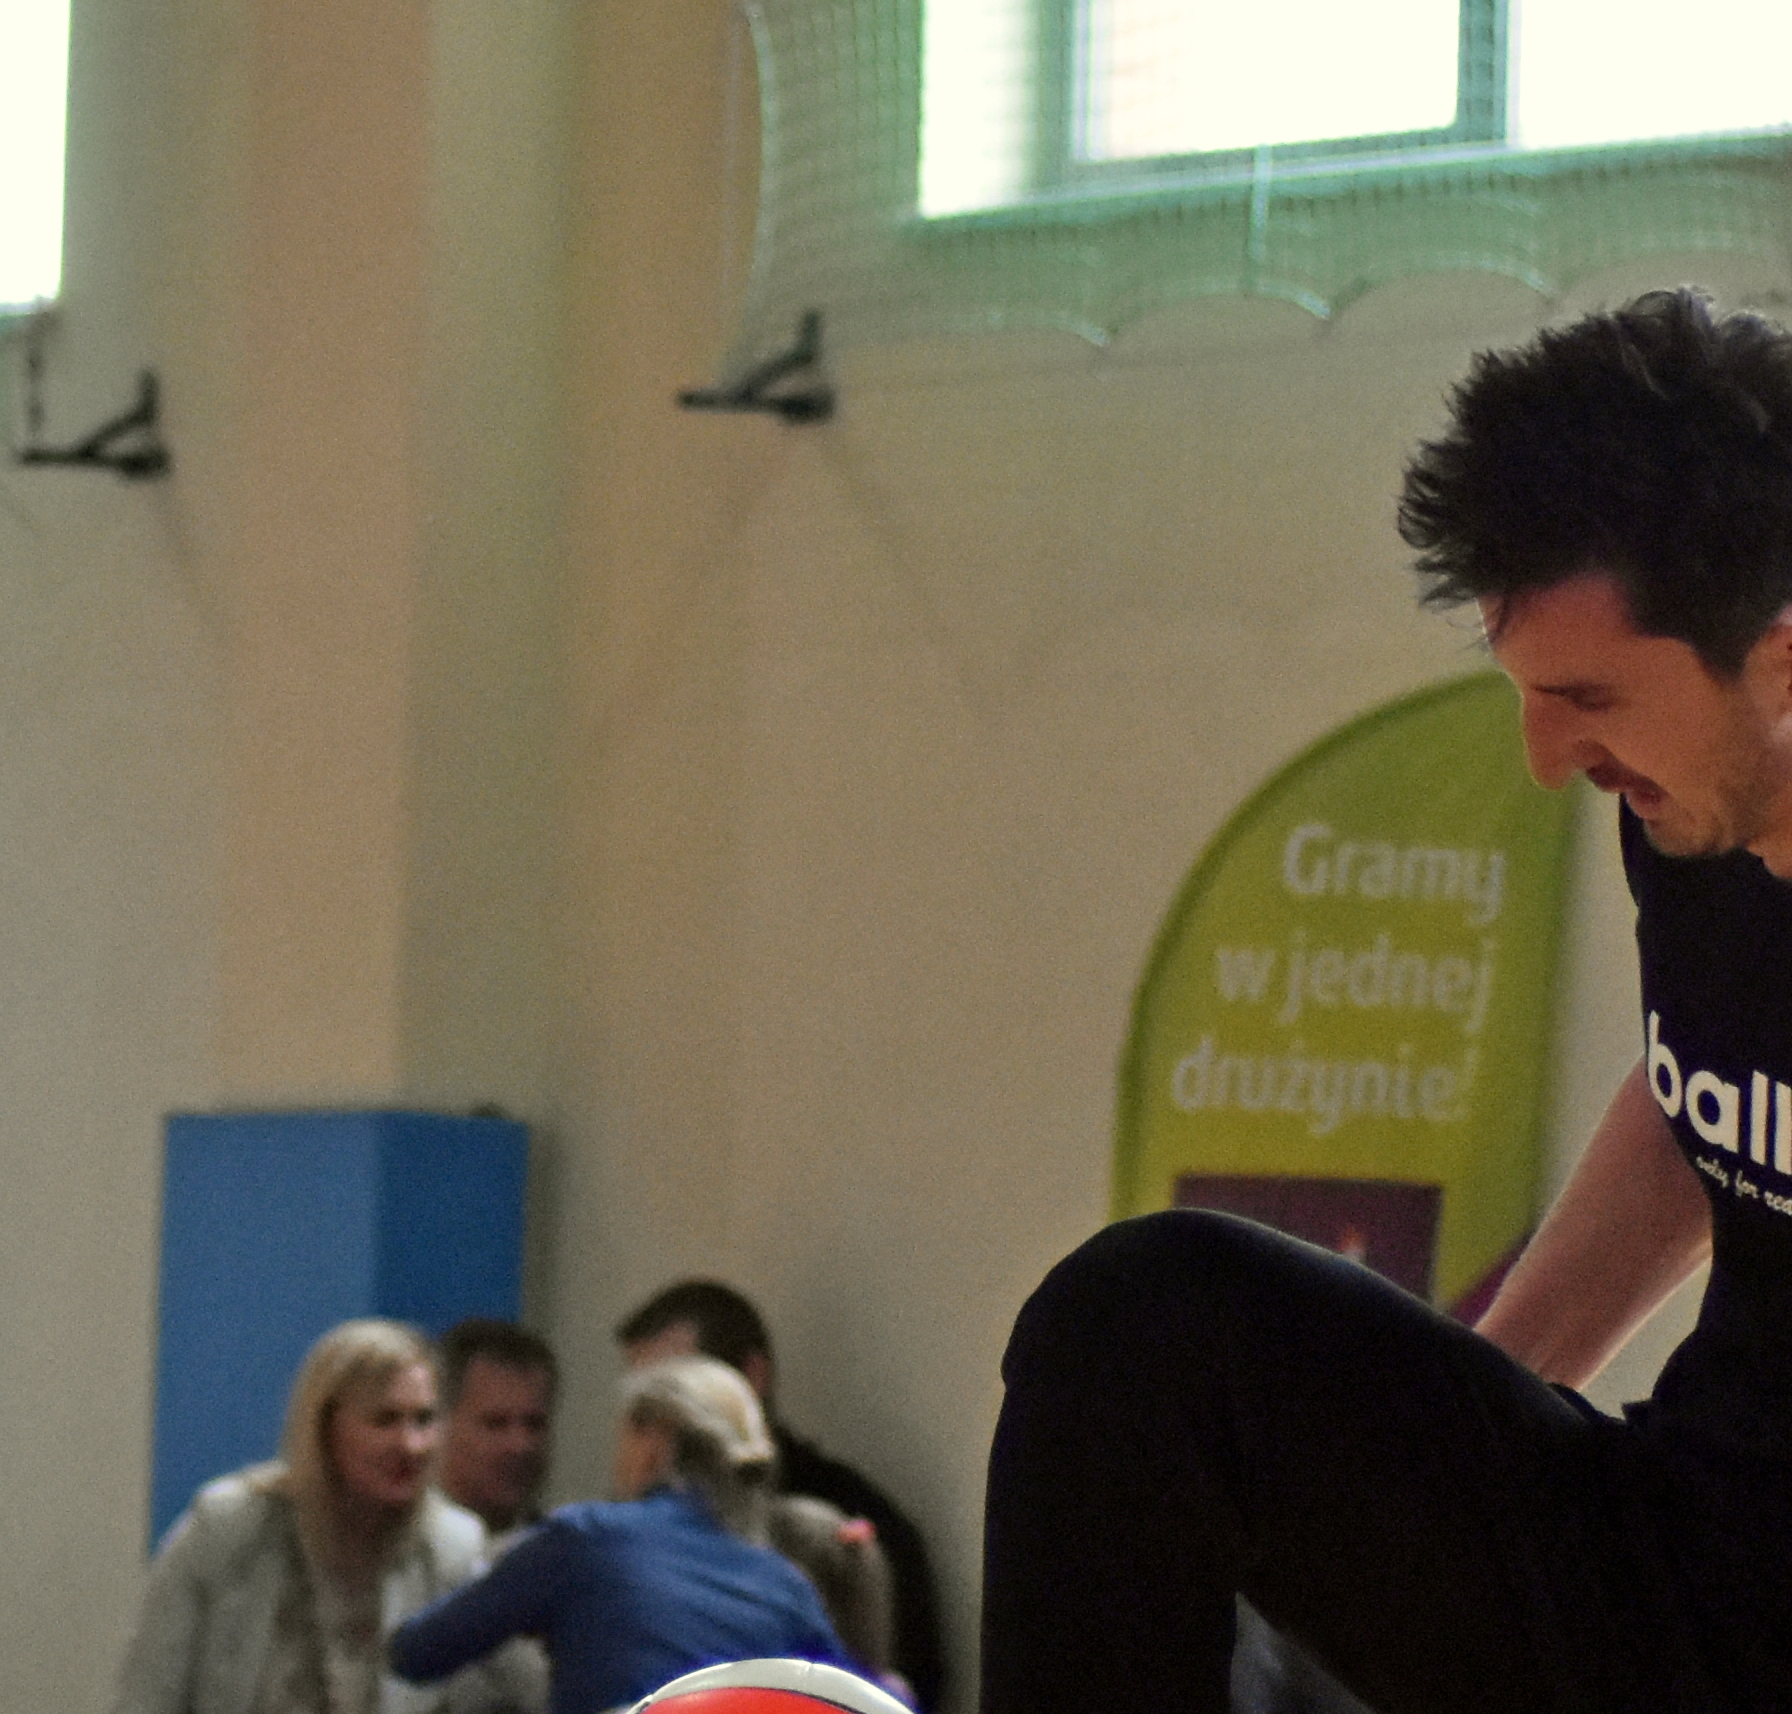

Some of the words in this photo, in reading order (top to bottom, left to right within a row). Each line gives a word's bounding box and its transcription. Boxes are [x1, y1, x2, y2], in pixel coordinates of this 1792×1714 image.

[1281, 820, 1505, 926] Gramy
[1215, 945, 1276, 1001] w
[1279, 932, 1495, 1035] jednej
[1734, 1169, 1759, 1199] for
